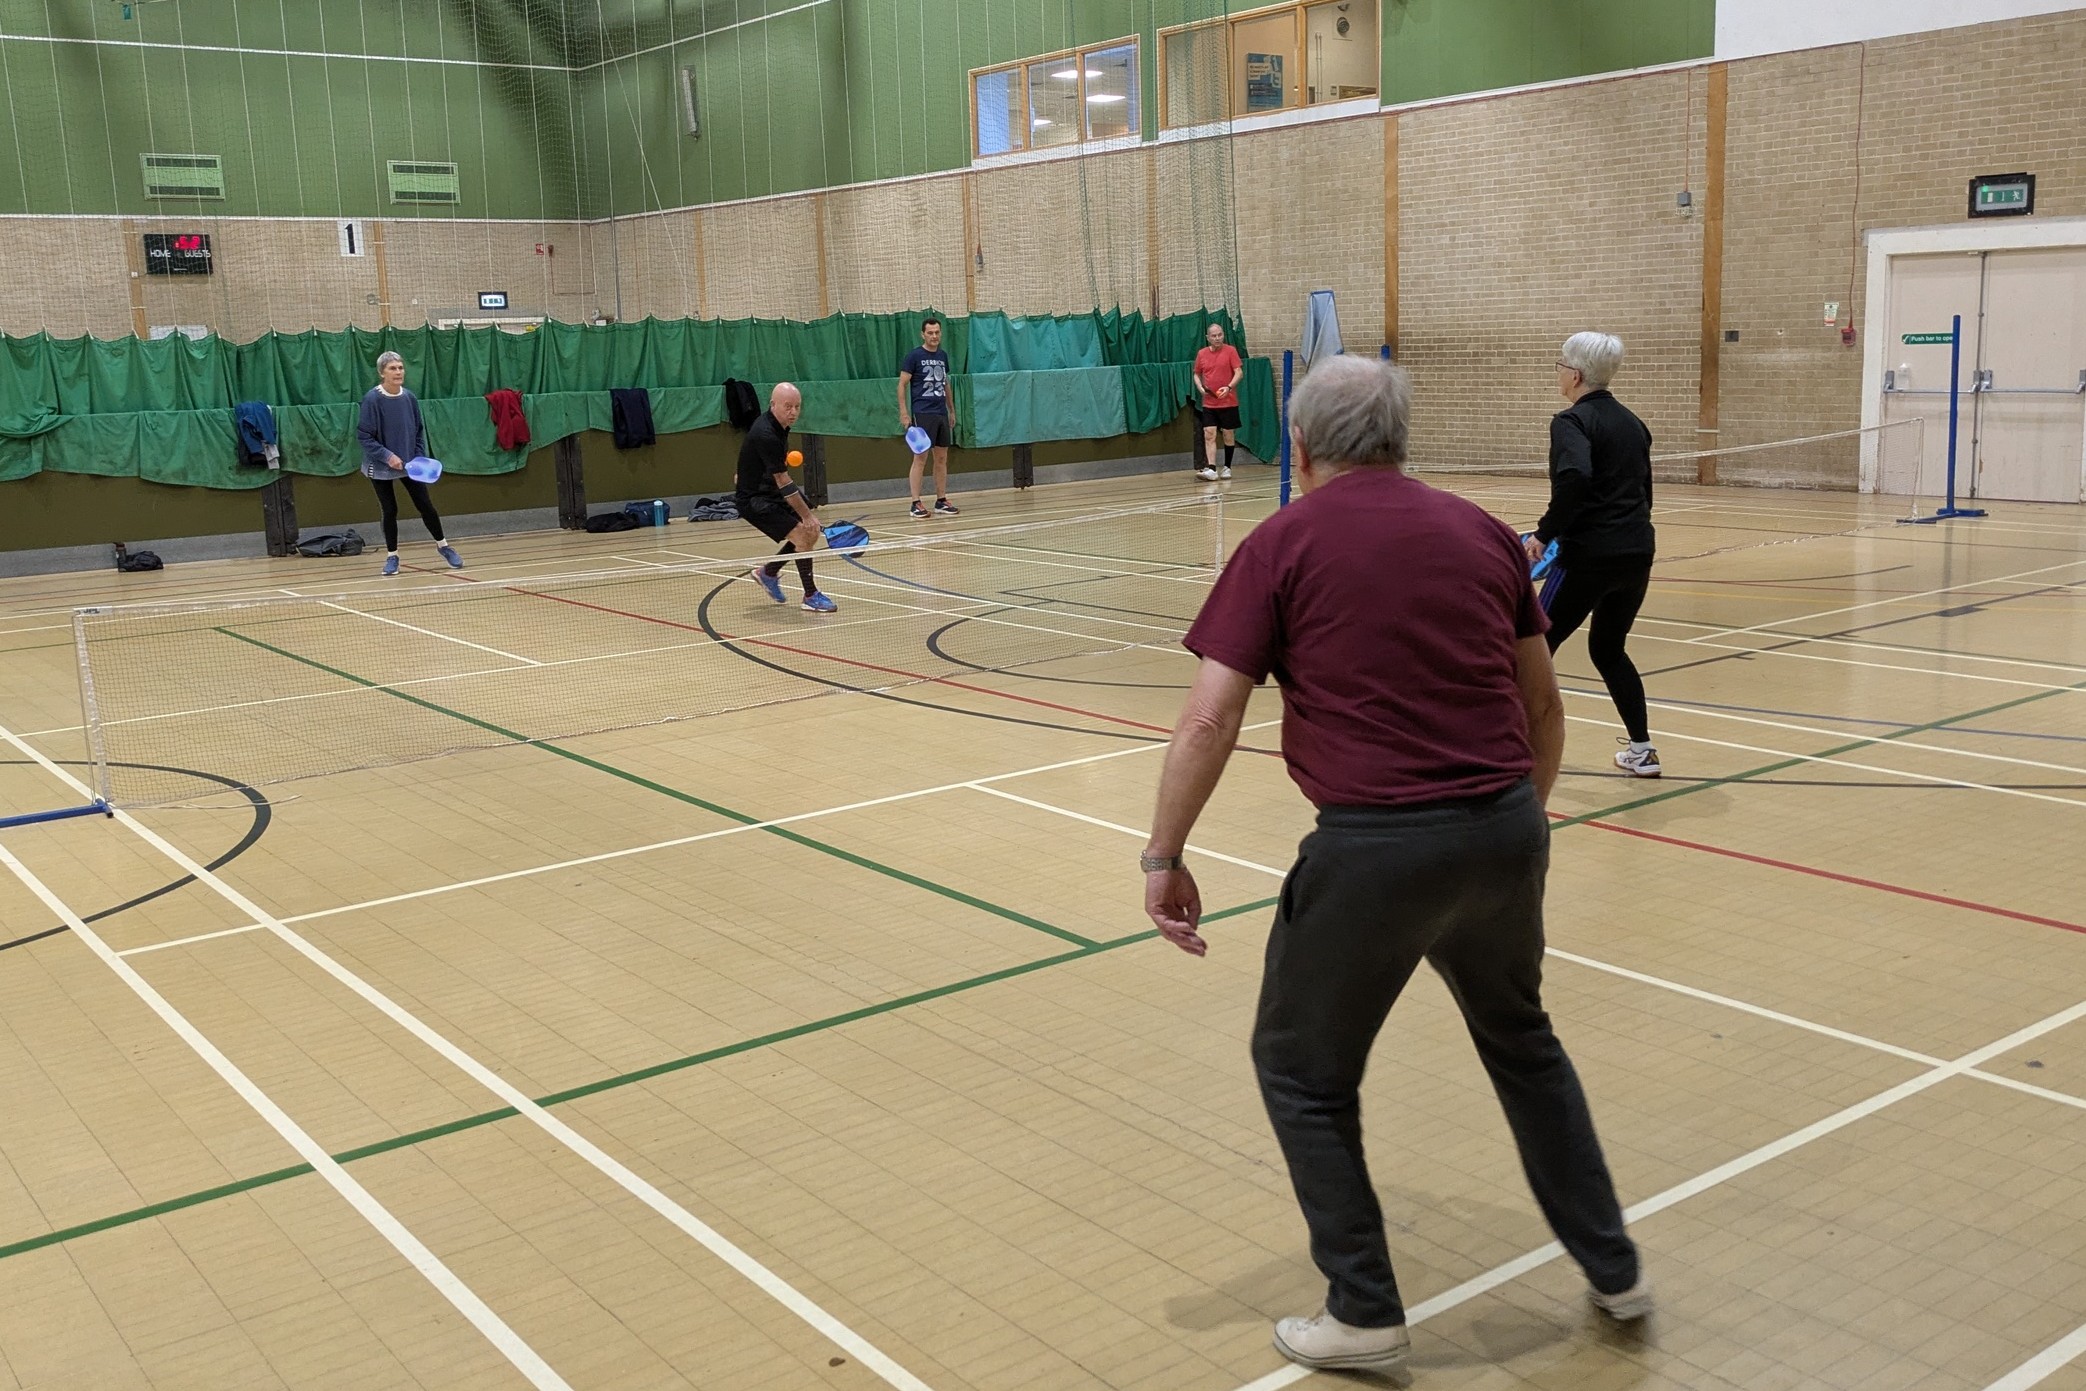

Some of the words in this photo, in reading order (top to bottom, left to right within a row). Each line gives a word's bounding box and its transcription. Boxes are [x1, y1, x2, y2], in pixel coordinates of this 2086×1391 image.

[345, 223, 355, 254] 1
[150, 249, 171, 257] HOME
[184, 249, 211, 257] GUESTS
[922, 366, 943, 381] 20
[922, 382, 944, 396] 23
